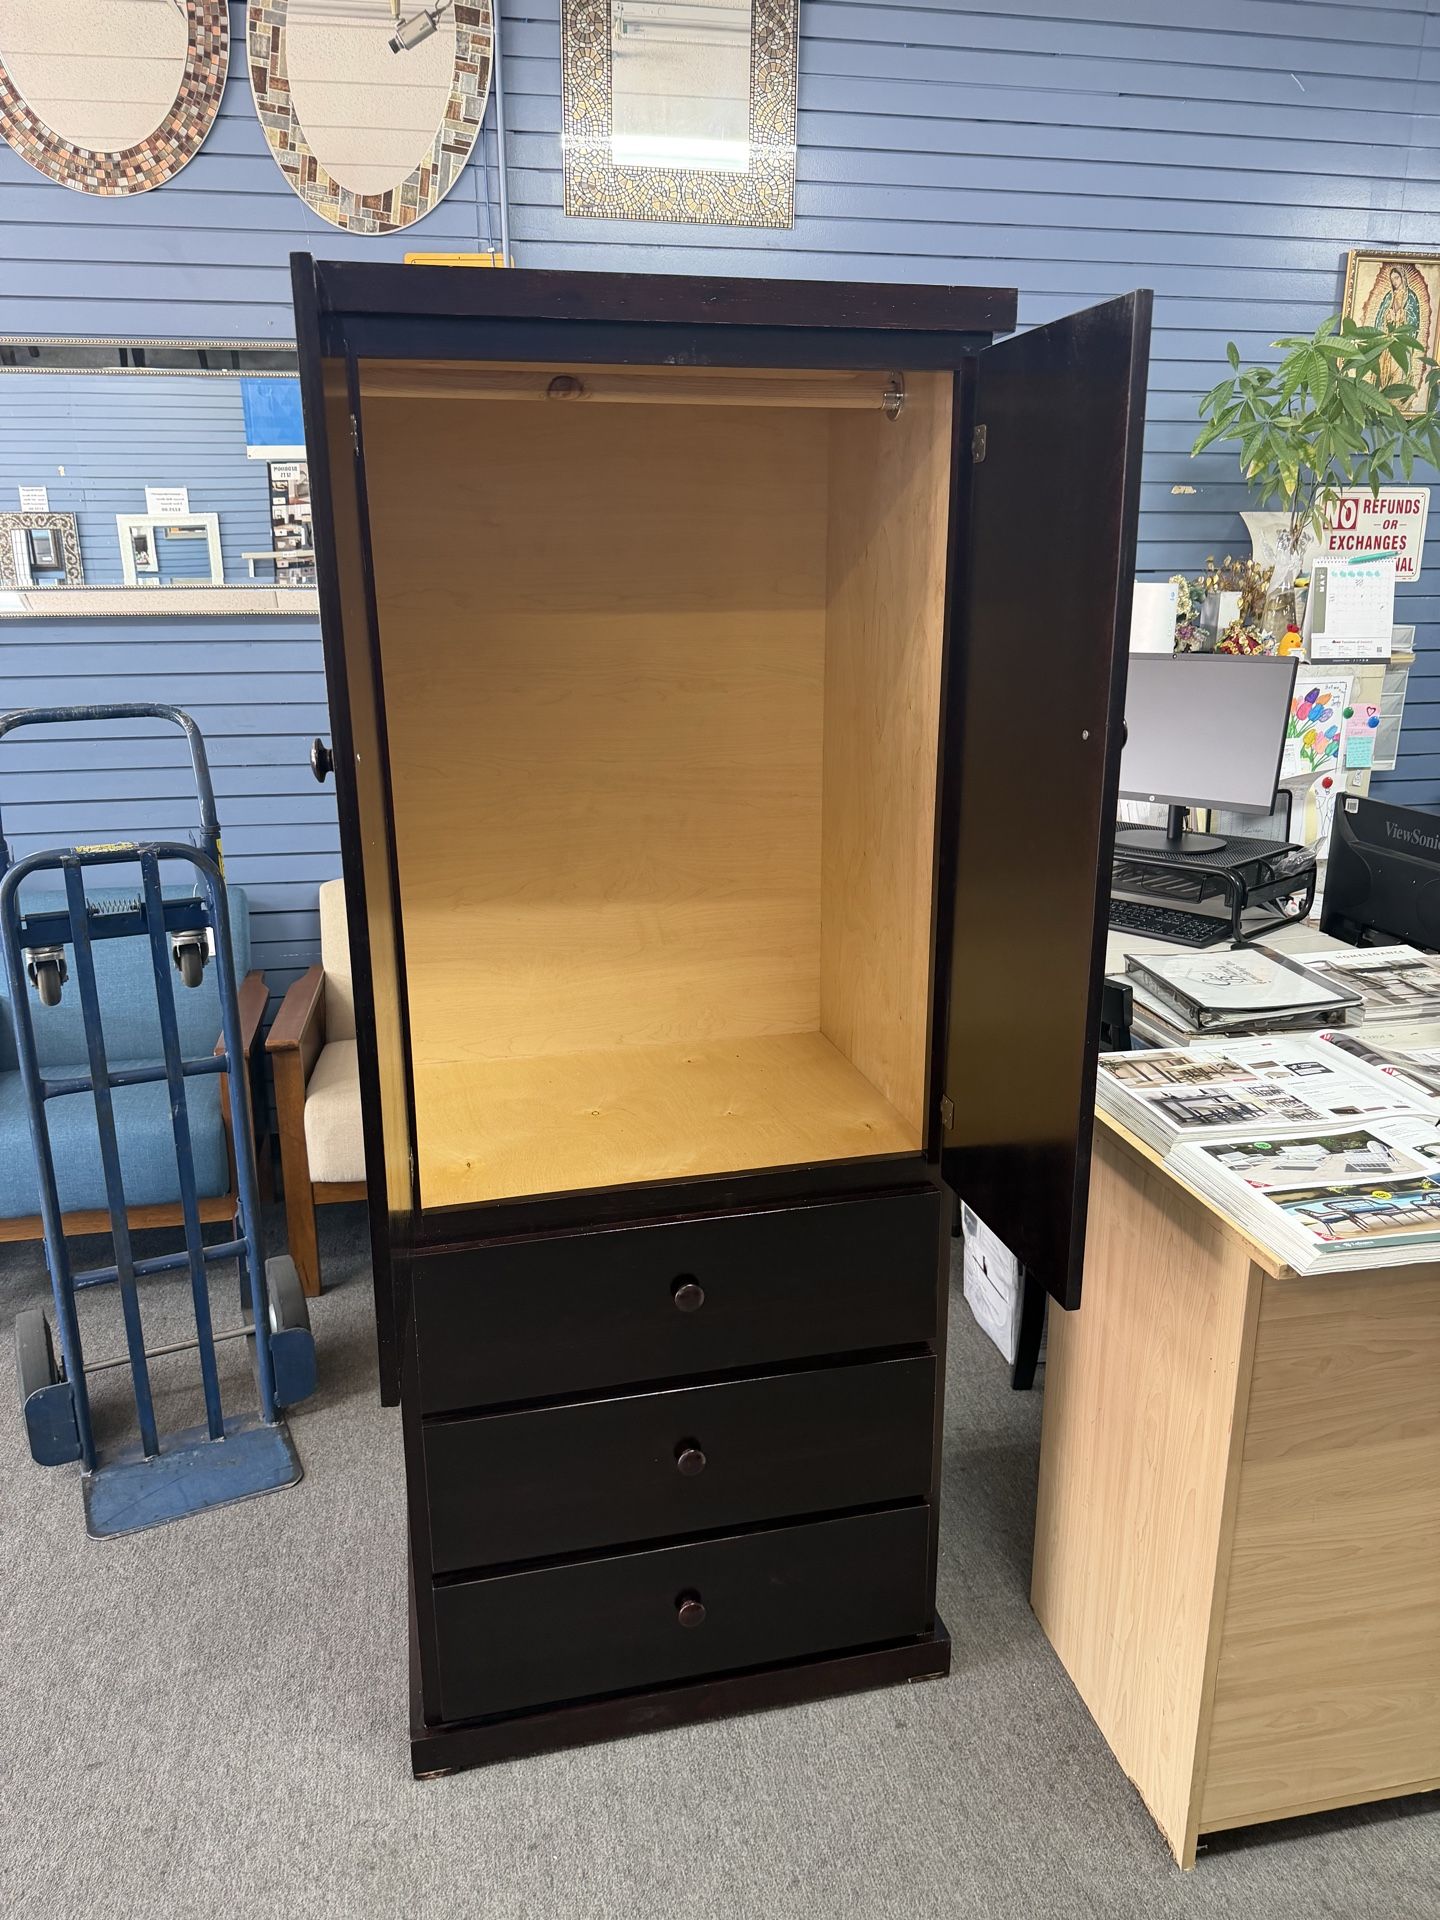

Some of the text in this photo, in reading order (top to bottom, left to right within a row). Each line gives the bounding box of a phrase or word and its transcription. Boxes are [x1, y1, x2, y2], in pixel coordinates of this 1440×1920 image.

[1324, 499, 1420, 530] NO REFUNDS
[1382, 519, 1398, 530] OR
[1329, 535, 1407, 550] EXCHANGES
[1395, 557, 1413, 571] NAL
